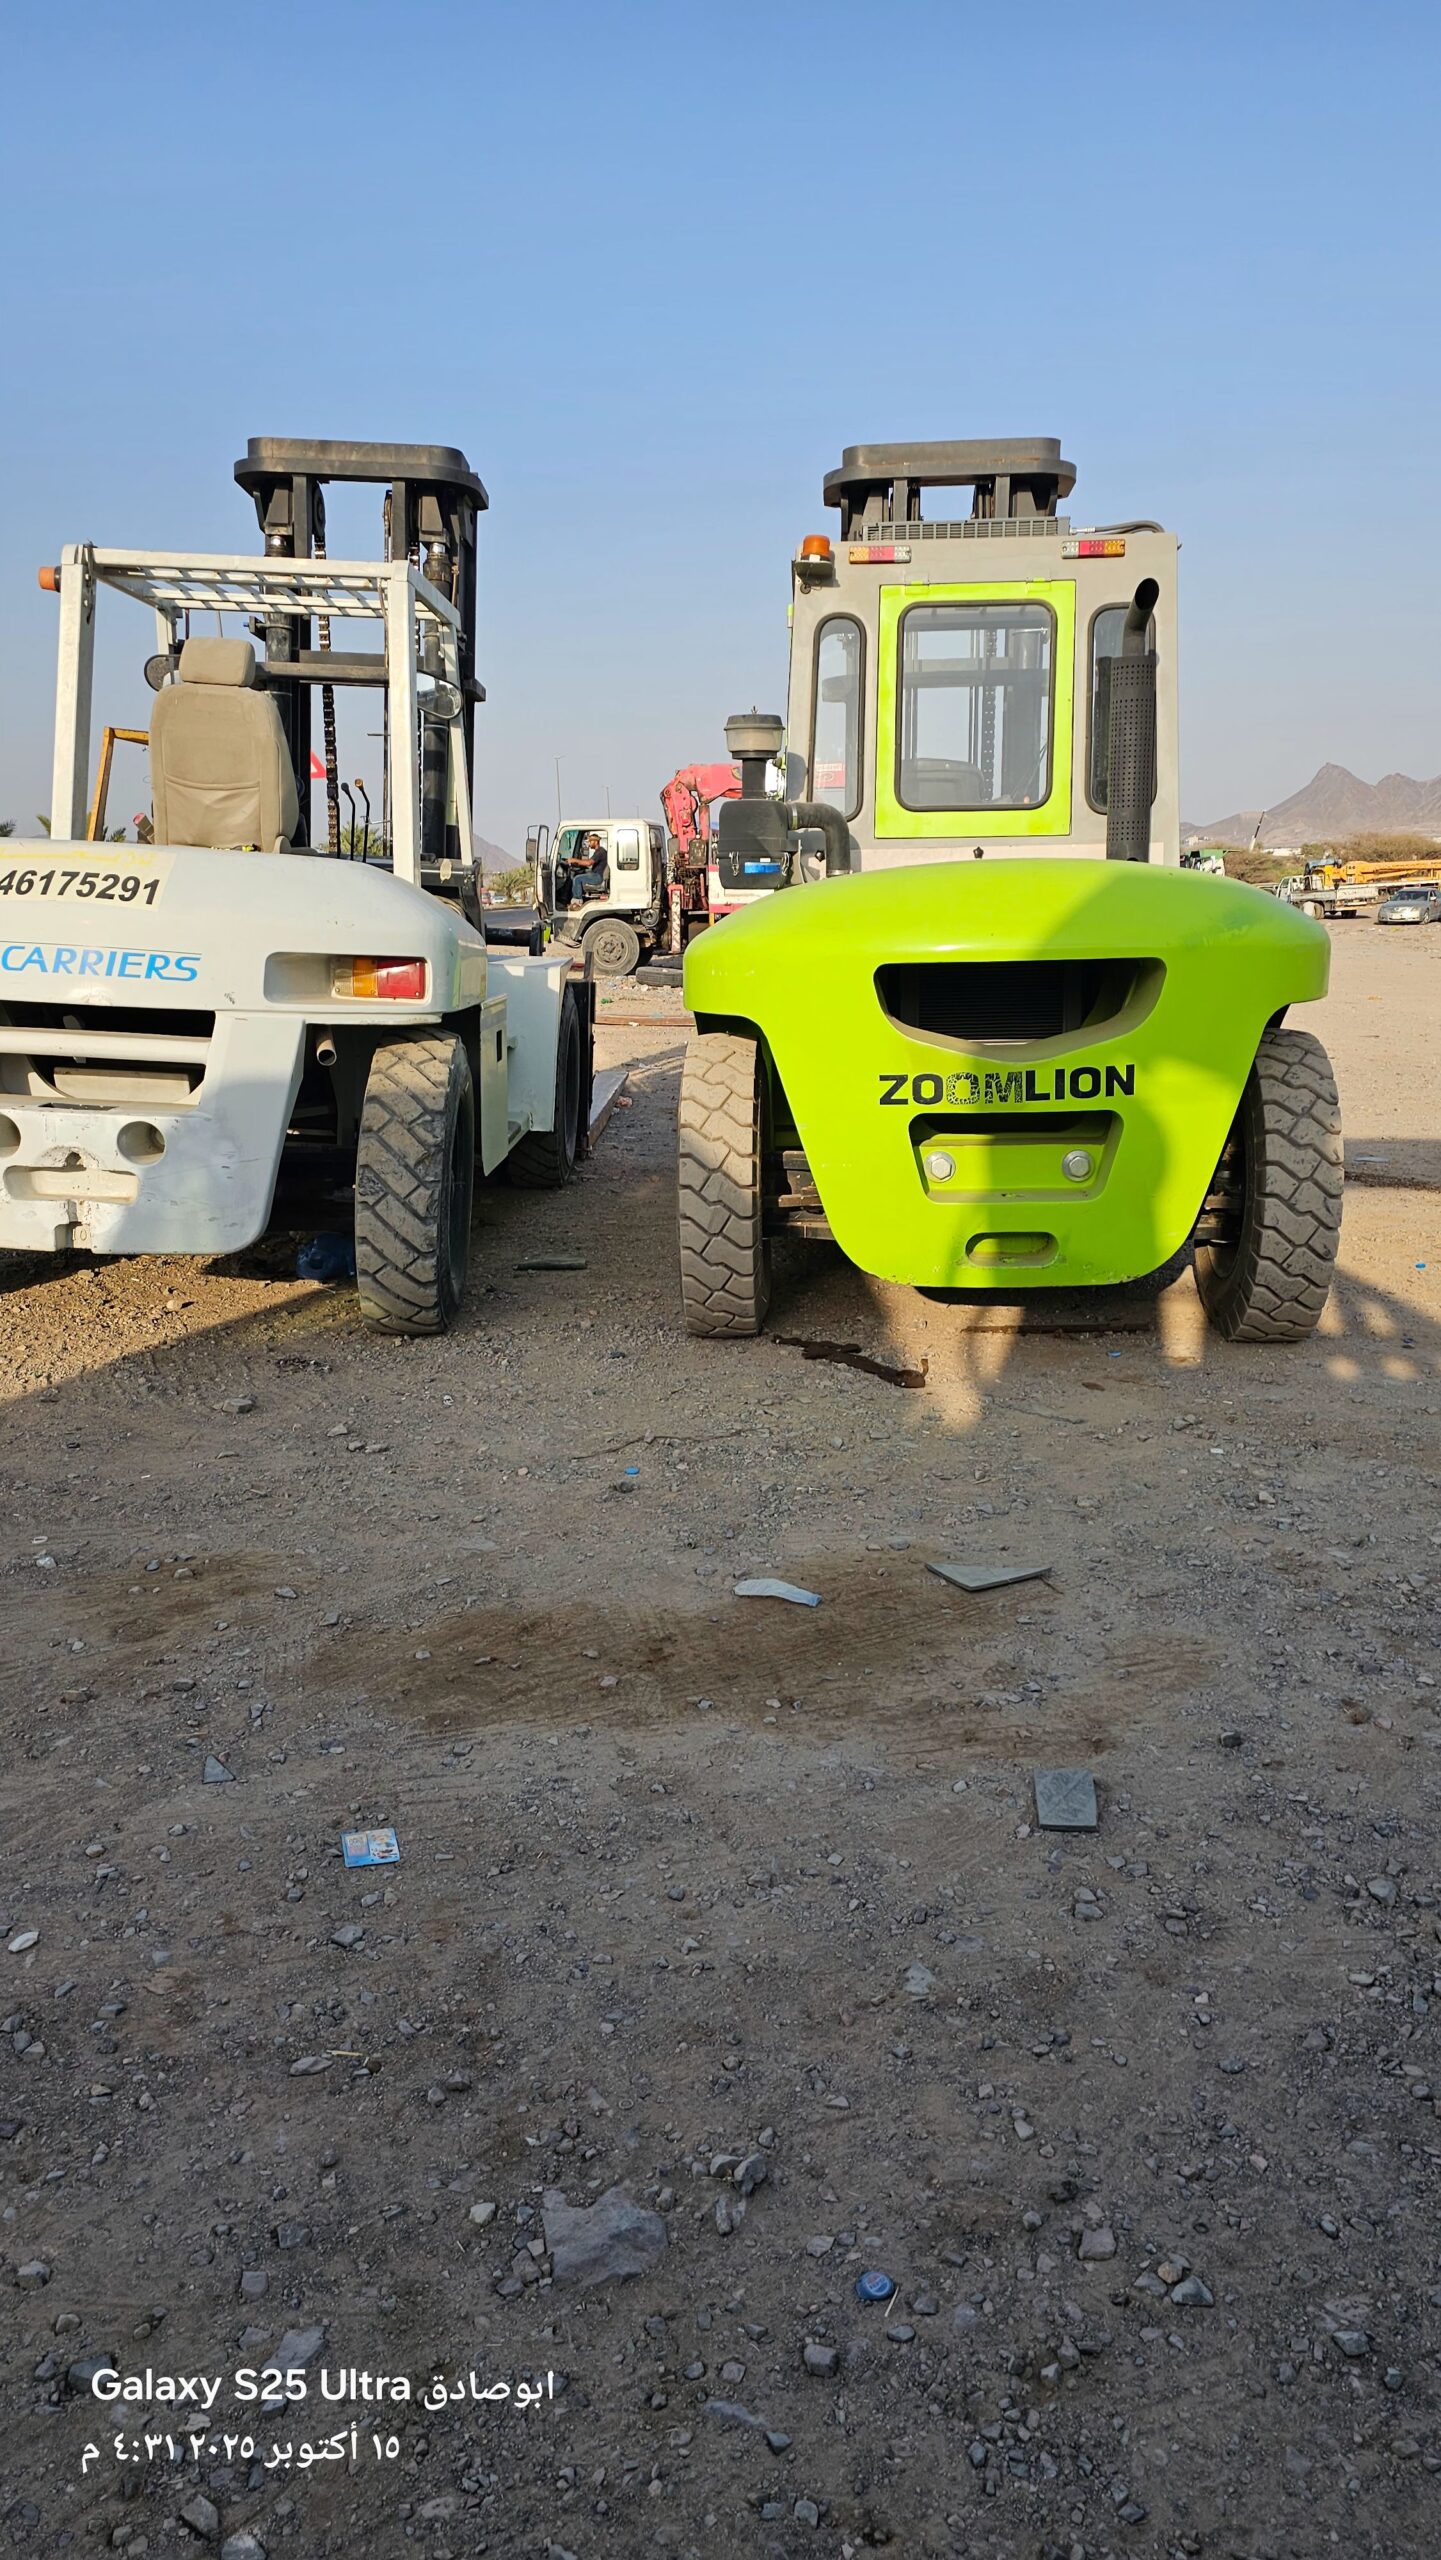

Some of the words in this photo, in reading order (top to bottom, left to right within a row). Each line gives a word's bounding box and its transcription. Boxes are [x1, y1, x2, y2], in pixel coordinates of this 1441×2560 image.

[0, 869, 160, 905] 46175291
[1, 945, 201, 982] CARRIERS
[879, 1064, 1135, 1105] ZOOMLION
